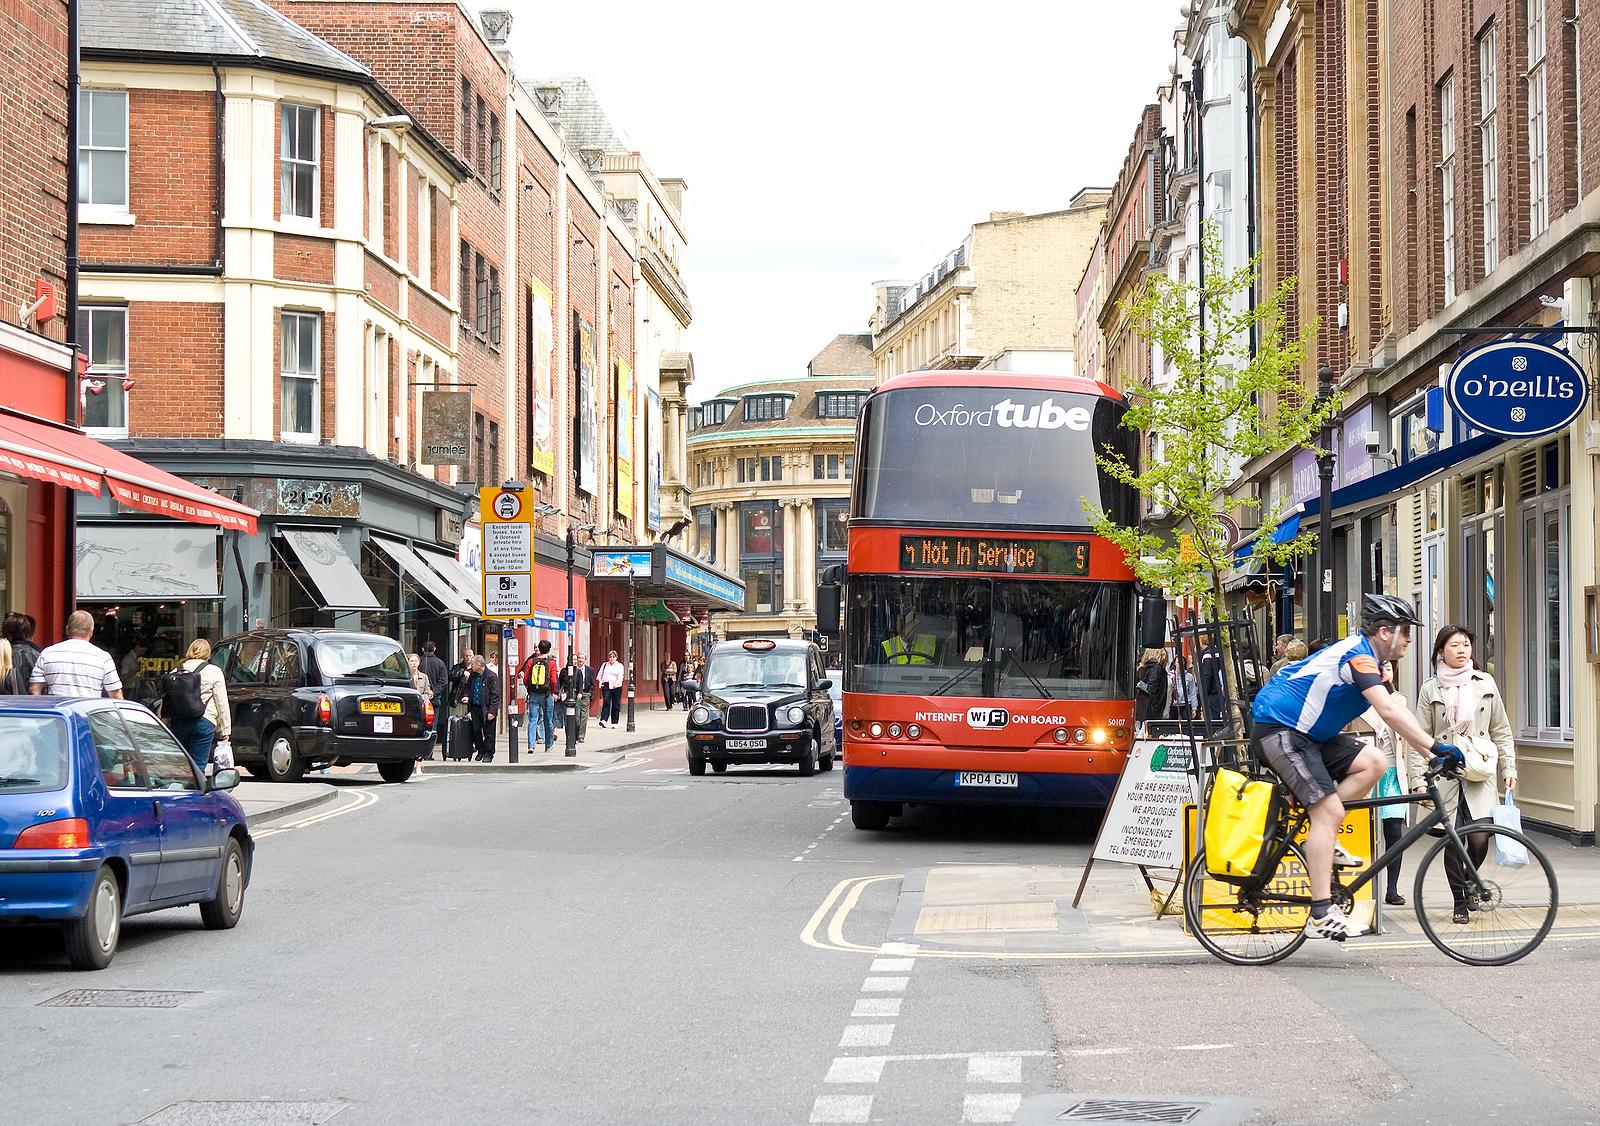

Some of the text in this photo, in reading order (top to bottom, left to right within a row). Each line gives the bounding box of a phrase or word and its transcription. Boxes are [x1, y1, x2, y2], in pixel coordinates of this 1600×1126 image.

[1463, 374, 1574, 398] o'neill's
[914, 398, 1091, 431] Oxford tube
[922, 540, 950, 565] Not
[956, 542, 971, 566] In
[978, 542, 1034, 568] Service
[915, 711, 964, 722] INTERNET
[1012, 714, 1028, 724] ON
[1030, 715, 1067, 725] BOARD
[962, 773, 1016, 784] KP04 GJV
[1135, 782, 1190, 794] WE ARE REPAIRING
[1127, 792, 1192, 804] YOUR ROADS FOR YOU
[1132, 805, 1177, 816] WE APOLOGISE
[1137, 816, 1164, 826] FOR ANY
[1121, 825, 1173, 838] INCONVENIENCE
[1124, 836, 1163, 848] EMERGENCY
[1109, 845, 1119, 854] TEL
[1120, 846, 1129, 855] No
[1130, 848, 1146, 857] 0845
